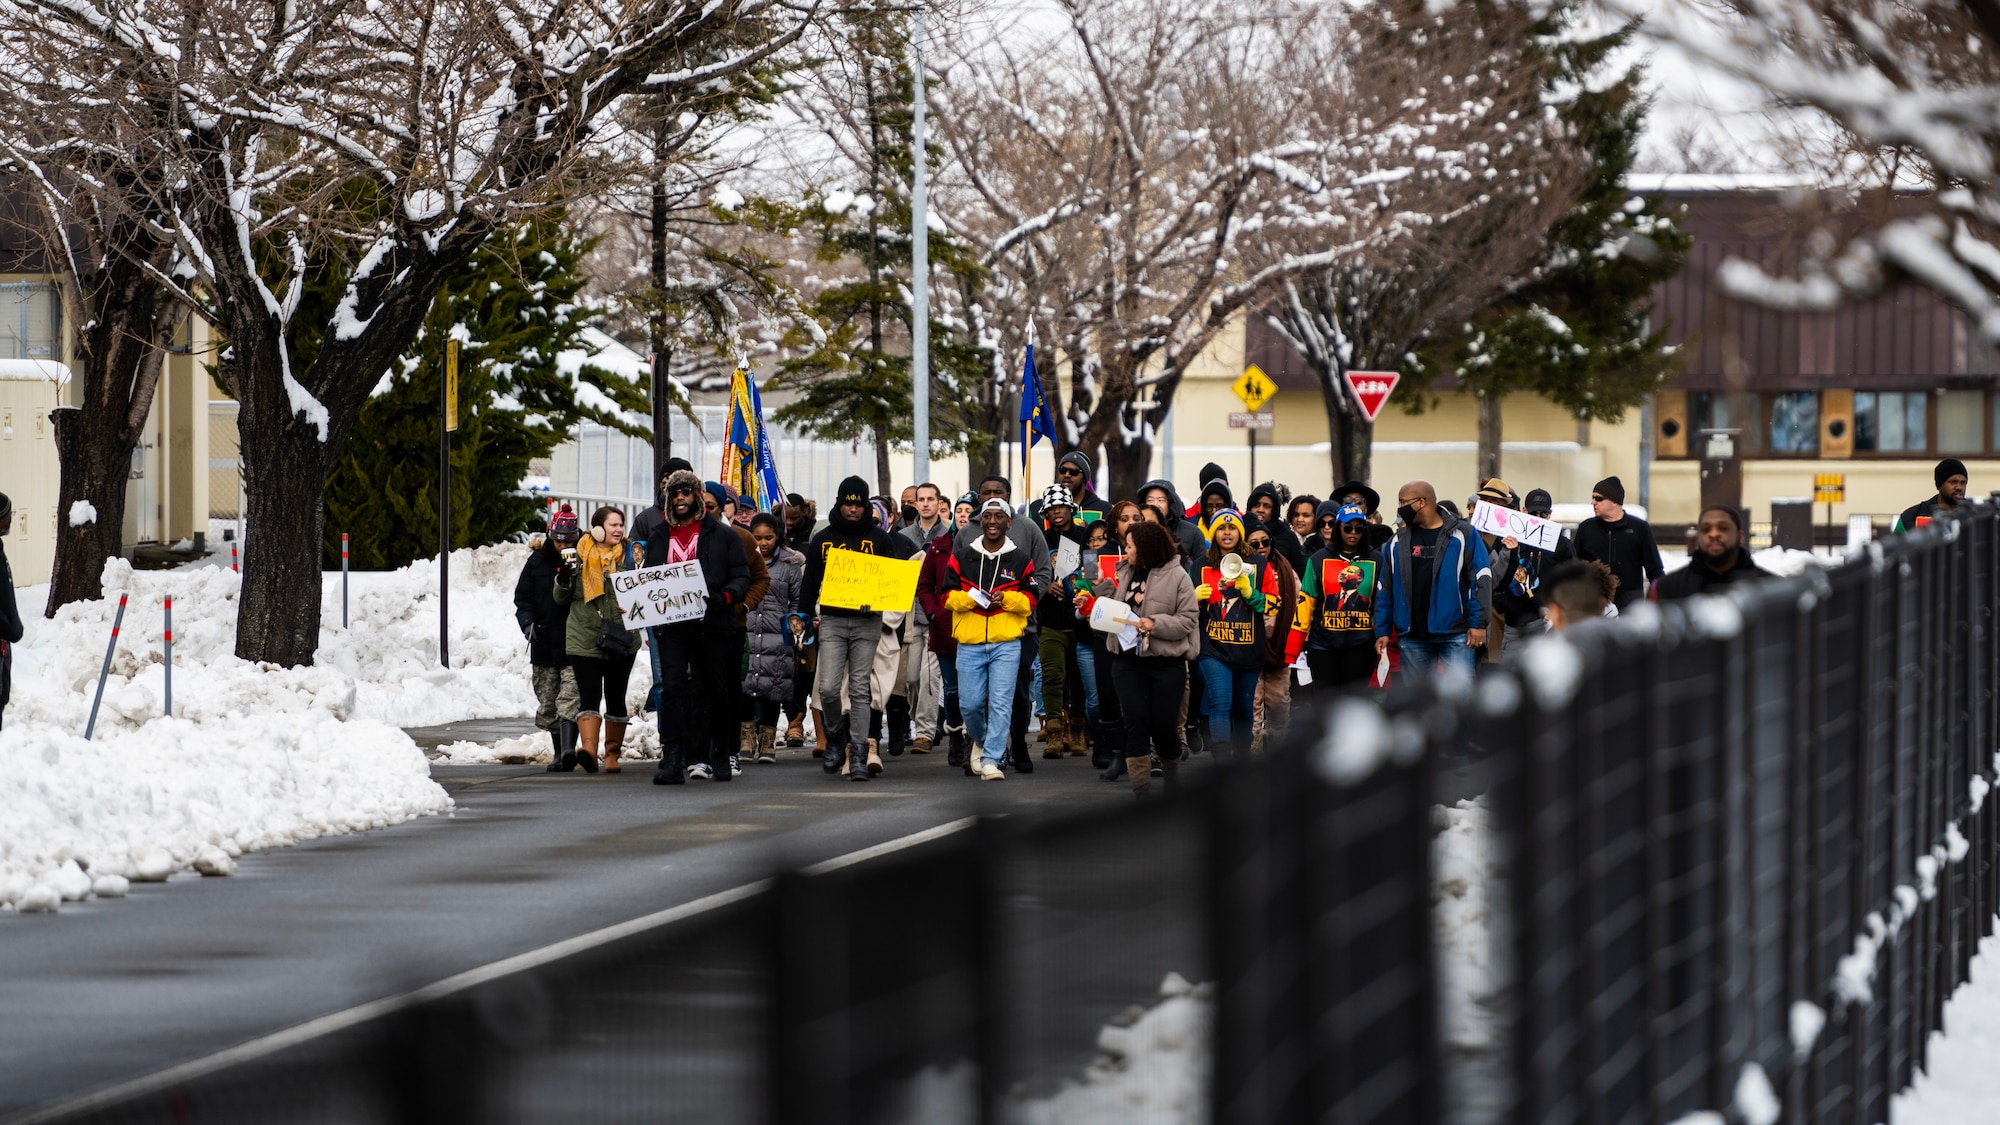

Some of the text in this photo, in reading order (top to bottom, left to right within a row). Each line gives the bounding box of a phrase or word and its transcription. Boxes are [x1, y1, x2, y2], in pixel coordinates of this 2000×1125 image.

[831, 556, 857, 573] APA
[615, 563, 698, 593] CELEBRATE
[655, 589, 703, 614] UNITY
[1324, 617, 1370, 628] KING JR
[1209, 628, 1251, 641] KING JR
